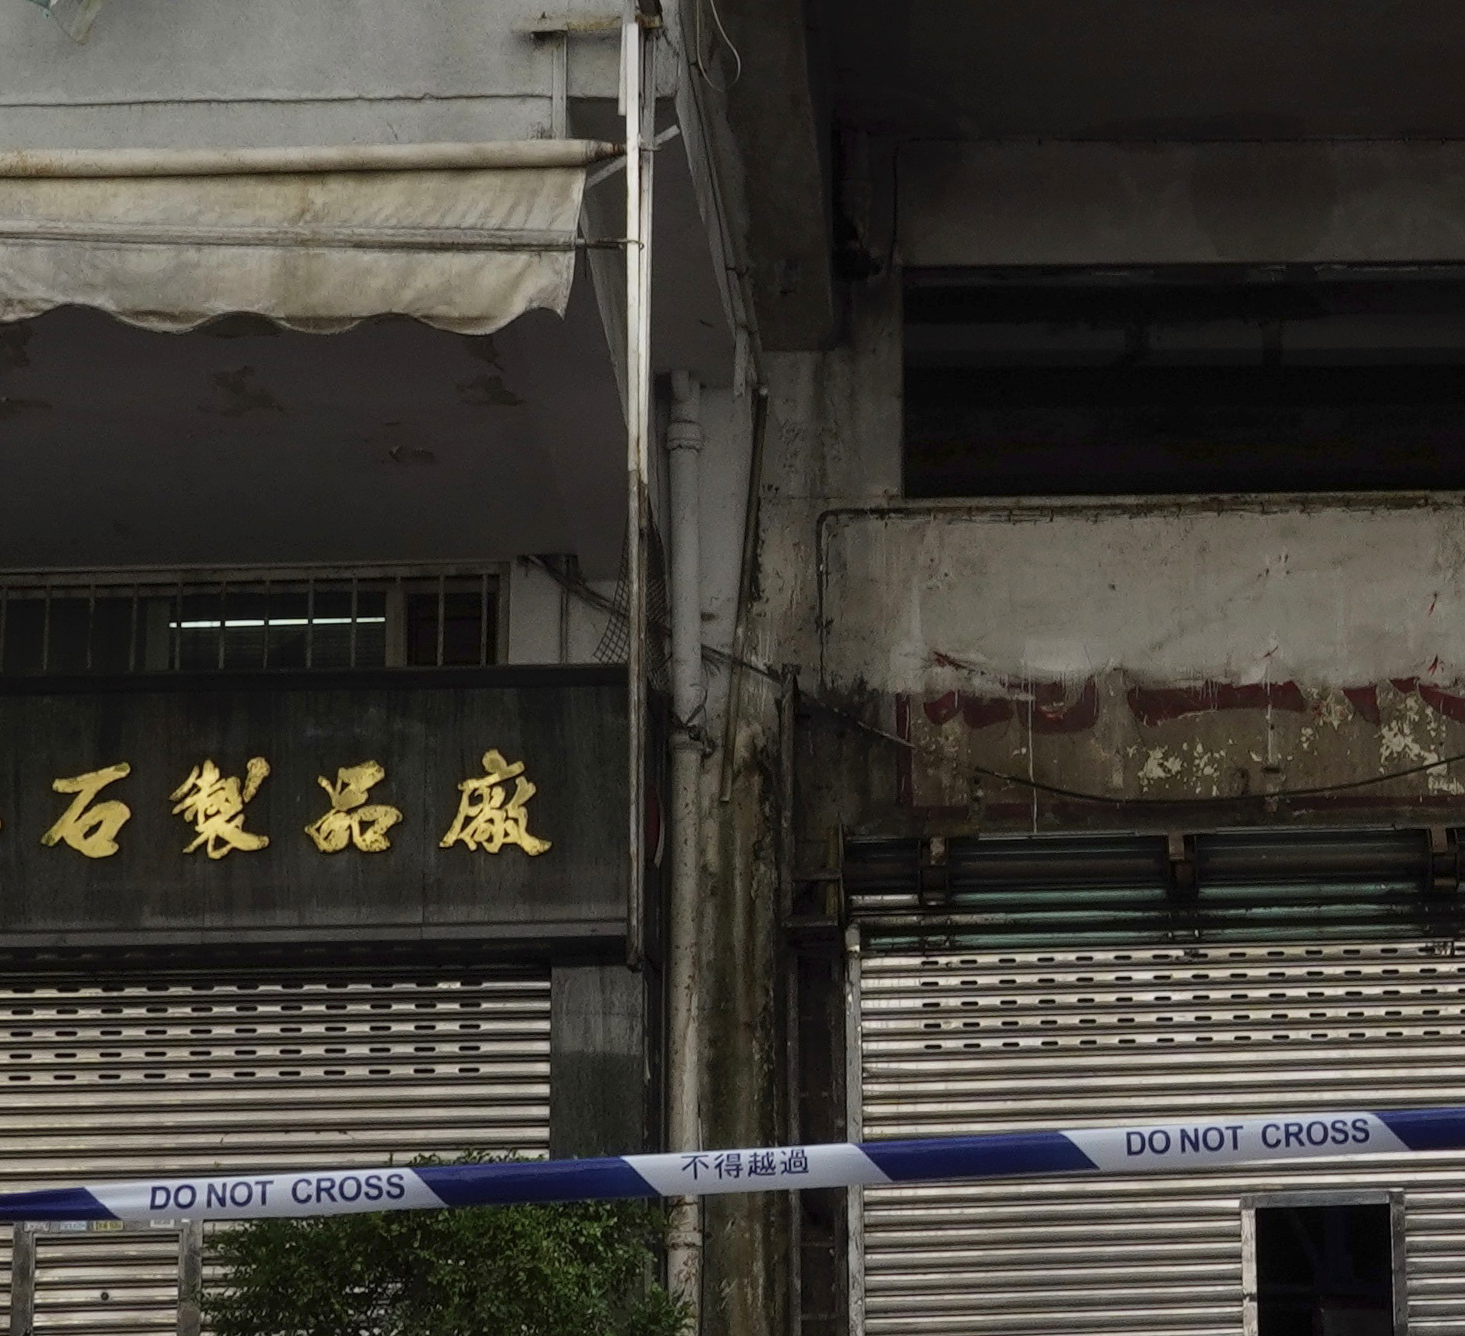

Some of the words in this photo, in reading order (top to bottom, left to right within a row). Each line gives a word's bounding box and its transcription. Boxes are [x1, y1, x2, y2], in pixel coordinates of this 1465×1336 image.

[1125, 1129, 1171, 1156] DO
[1180, 1125, 1244, 1153] NOT
[1260, 1118, 1371, 1149] CROSS
[680, 1148, 810, 1180] 不得越過
[149, 1184, 197, 1210] DO
[205, 1180, 275, 1208] NOT
[291, 1173, 405, 1204] CROSS
